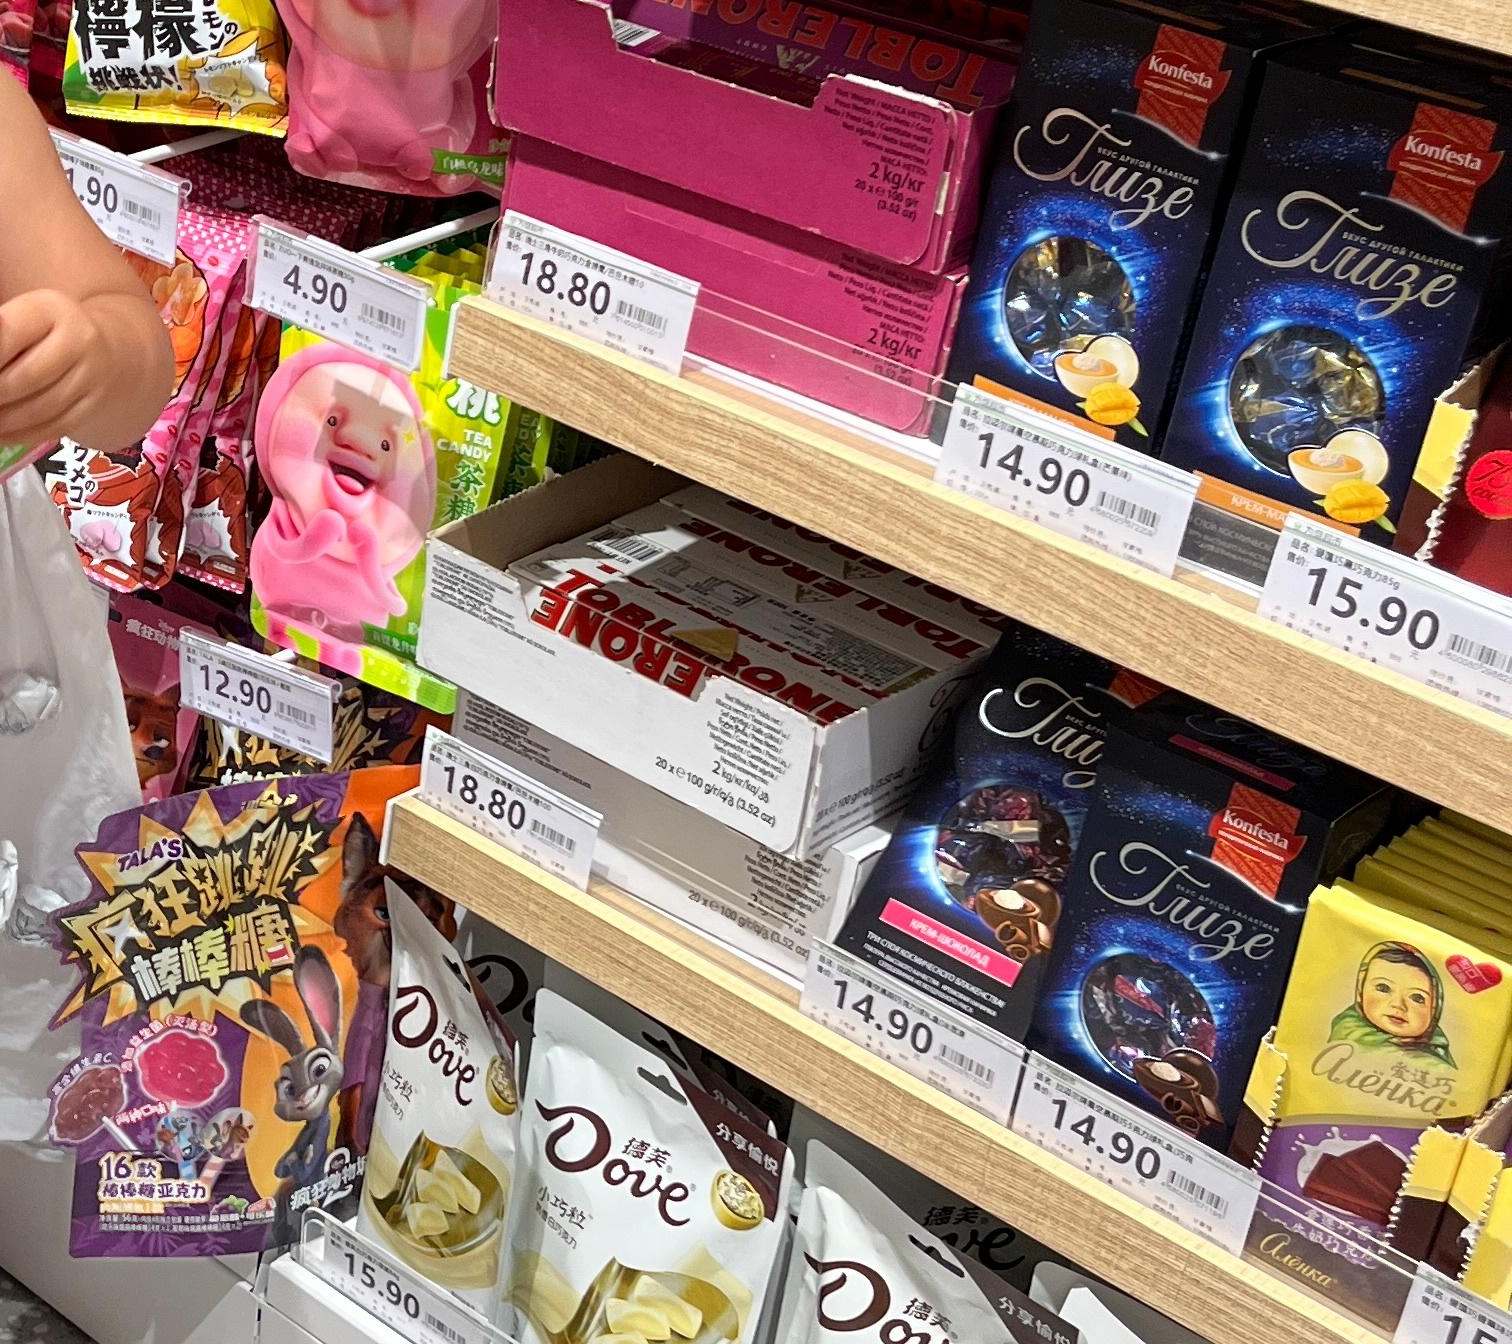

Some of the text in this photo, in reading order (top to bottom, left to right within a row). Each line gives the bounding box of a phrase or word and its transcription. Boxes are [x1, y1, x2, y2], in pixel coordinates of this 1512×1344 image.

[1149, 55, 1213, 90] Konfesta
[869, 162, 880, 180] 2
[1405, 135, 1482, 171] Konfesta
[1369, 238, 1406, 257] ДРУГОЙ
[282, 264, 348, 314] 4.90
[520, 252, 611, 316] 18.80
[867, 328, 877, 346] 2
[437, 439, 492, 463] CANDY
[464, 429, 492, 449] TEA
[977, 432, 1089, 507] 14.90
[1306, 566, 1440, 651] 15.90
[199, 664, 272, 714] 12.90
[655, 755, 669, 770] 20
[686, 771, 703, 788] 100
[444, 766, 526, 830] 18.80
[1222, 809, 1289, 849] Konfesta
[118, 838, 182, 872] TALA'S
[909, 919, 991, 968] КРЕМ-ШОКОЛАД
[833, 980, 933, 1055] 14.90
[392, 985, 478, 1106] Dove
[1312, 1043, 1451, 1115] Алёнка
[534, 1098, 689, 1226] Dove
[622, 1137, 672, 1166] 德芙
[715, 1122, 778, 1176] 分享愉悦
[1051, 1099, 1161, 1181] 14.90
[104, 1155, 132, 1181] 16
[538, 1184, 585, 1230] 小巧粒
[1260, 1232, 1336, 1288] Алёнка
[345, 1253, 420, 1319] 15.90
[901, 1298, 952, 1332] 德芙
